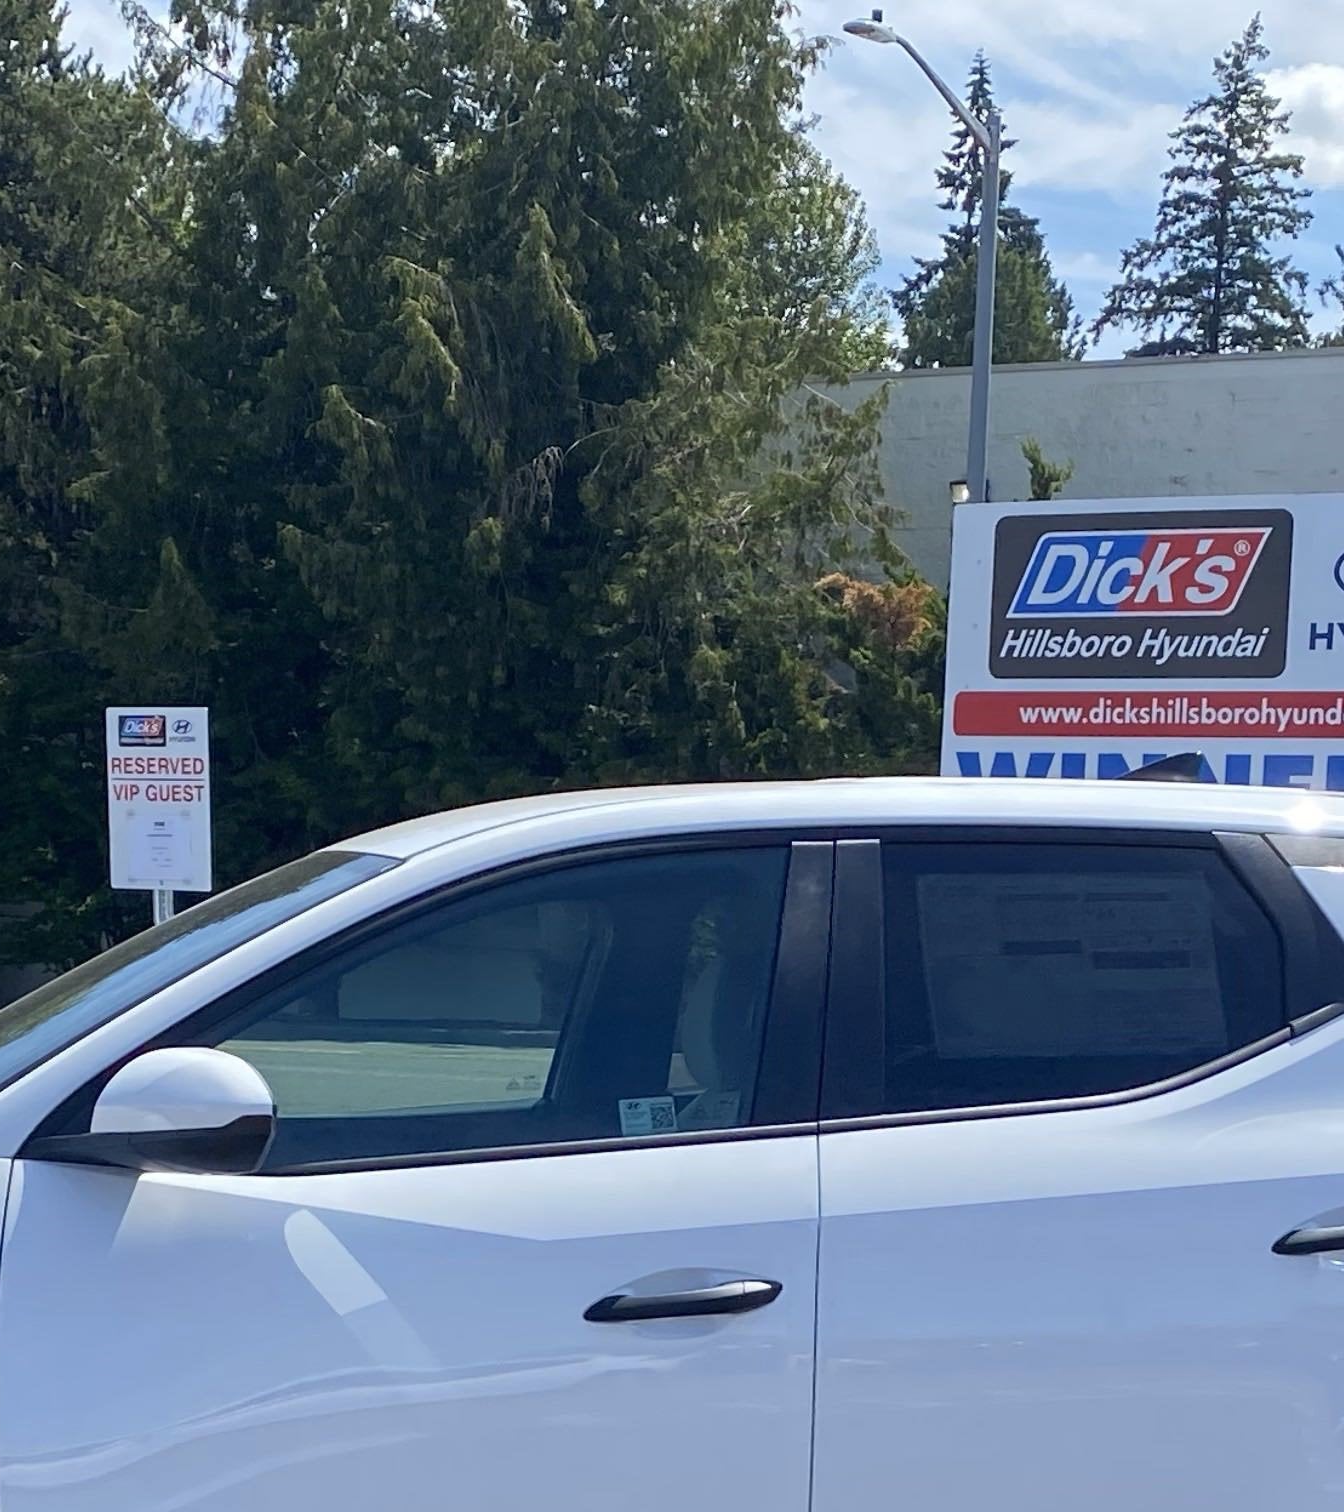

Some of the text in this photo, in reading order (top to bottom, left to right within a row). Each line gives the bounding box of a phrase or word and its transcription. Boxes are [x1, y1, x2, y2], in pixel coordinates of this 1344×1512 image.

[1026, 539, 1236, 605] Dick's
[1000, 627, 1270, 666] Hillsboro Hyundai
[111, 757, 205, 775] RESERVED
[113, 784, 205, 802] VIP GUEST
